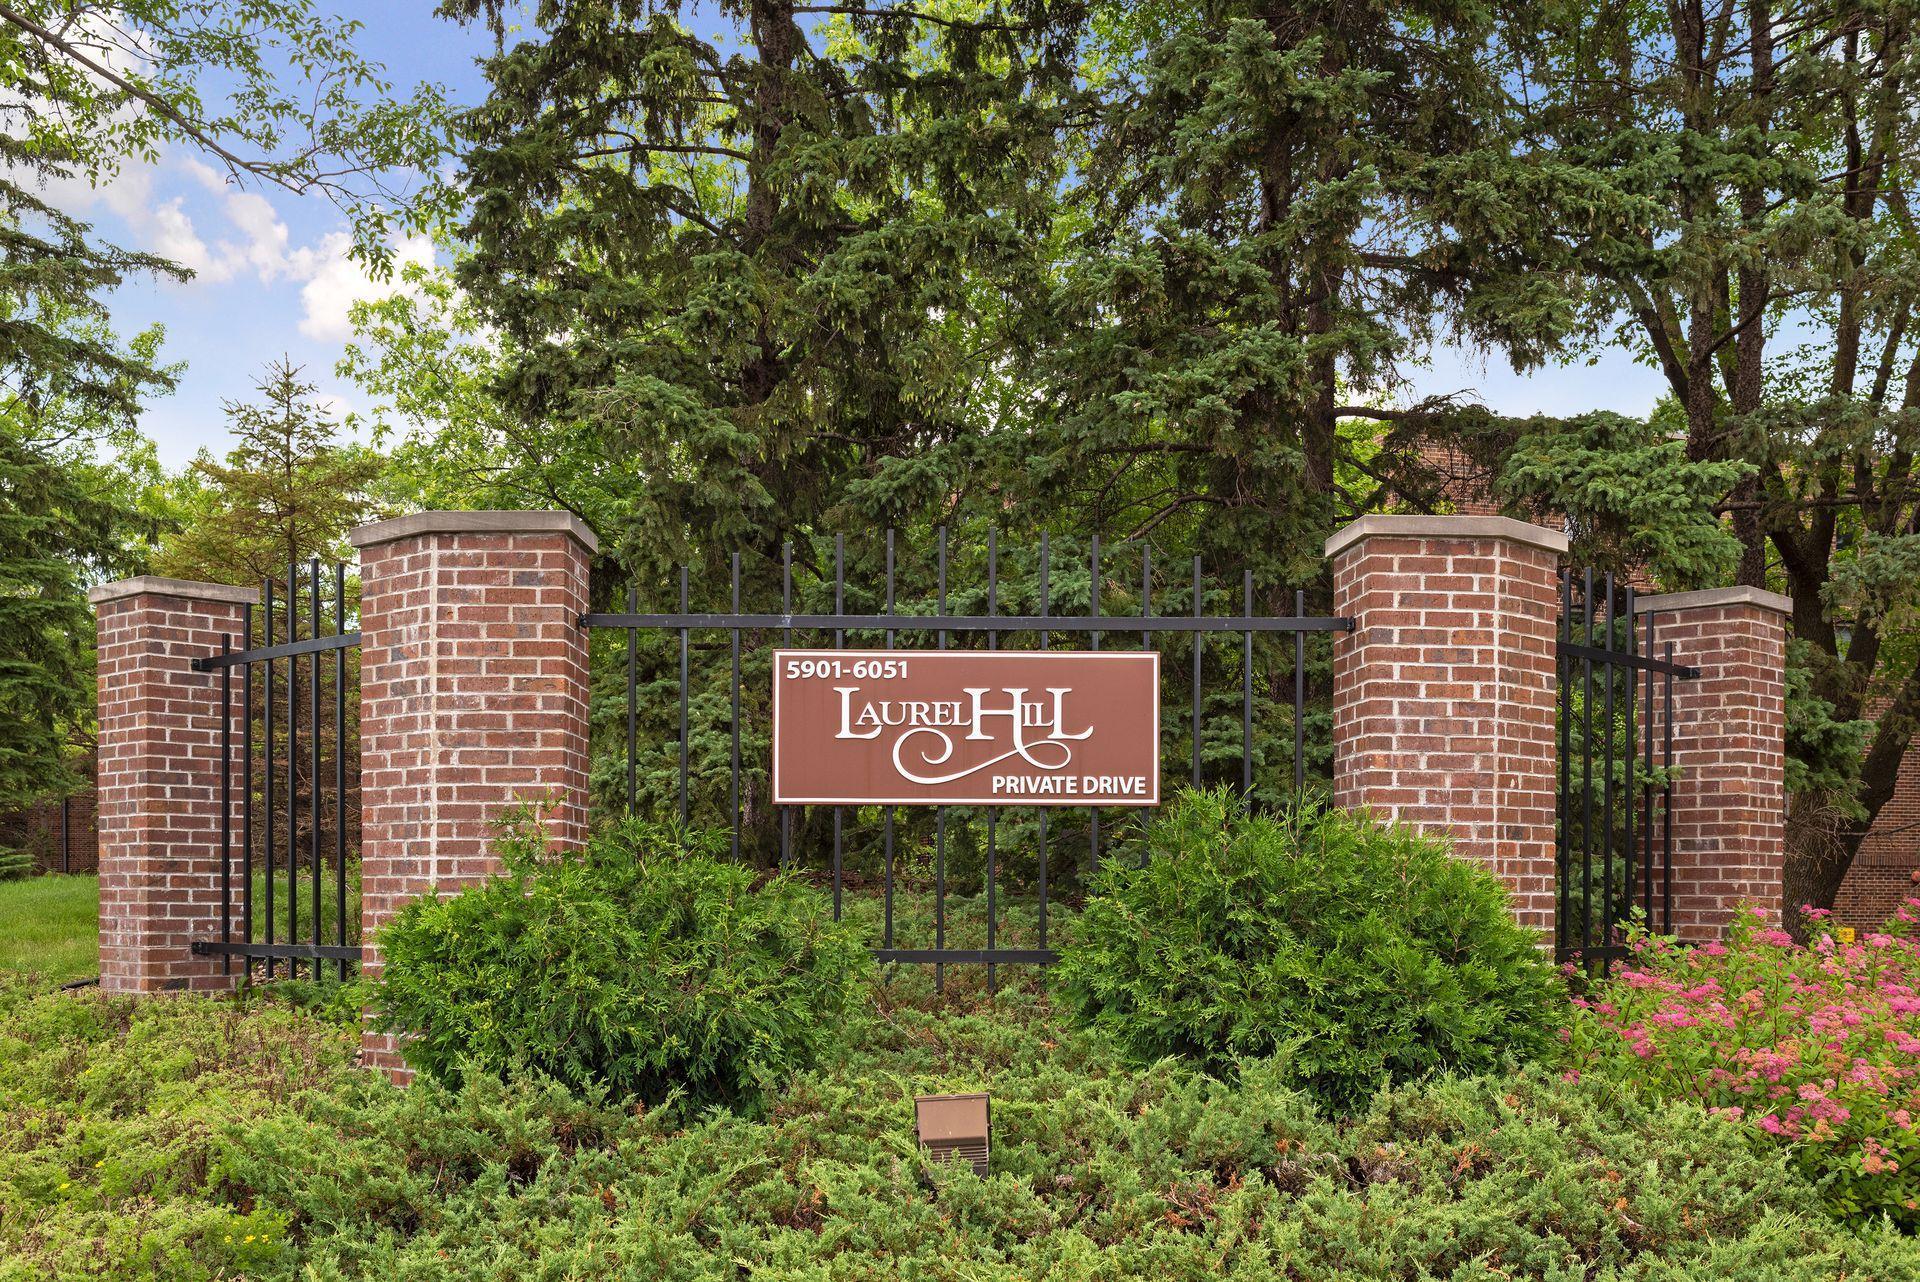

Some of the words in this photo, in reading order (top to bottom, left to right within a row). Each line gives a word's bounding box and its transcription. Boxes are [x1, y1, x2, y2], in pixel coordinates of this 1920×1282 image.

[785, 659, 908, 680] 5901-6051
[991, 775, 1078, 795] PRIVATE
[1082, 775, 1147, 795] DRIVE
